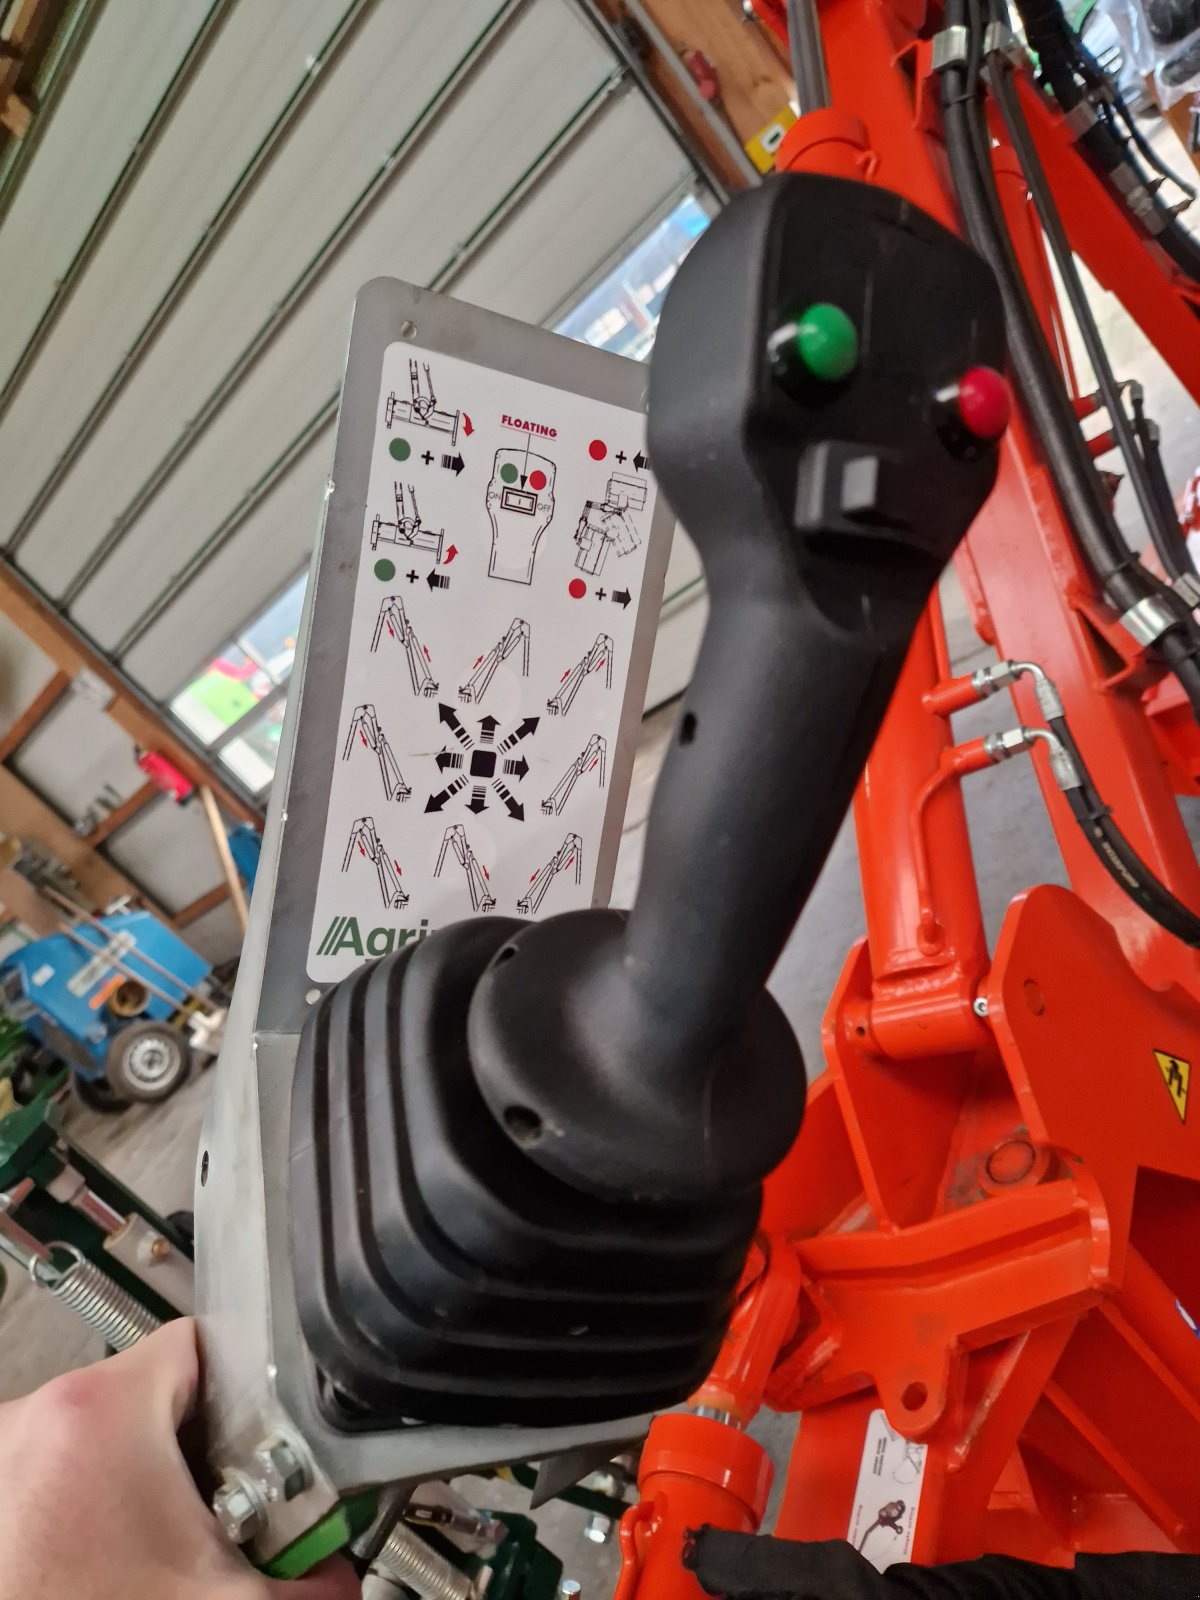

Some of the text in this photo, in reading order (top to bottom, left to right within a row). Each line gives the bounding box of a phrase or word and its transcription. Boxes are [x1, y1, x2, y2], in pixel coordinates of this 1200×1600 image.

[502, 414, 557, 438] FLOATING
[488, 491, 502, 501] ON
[537, 502, 552, 512] OFF
